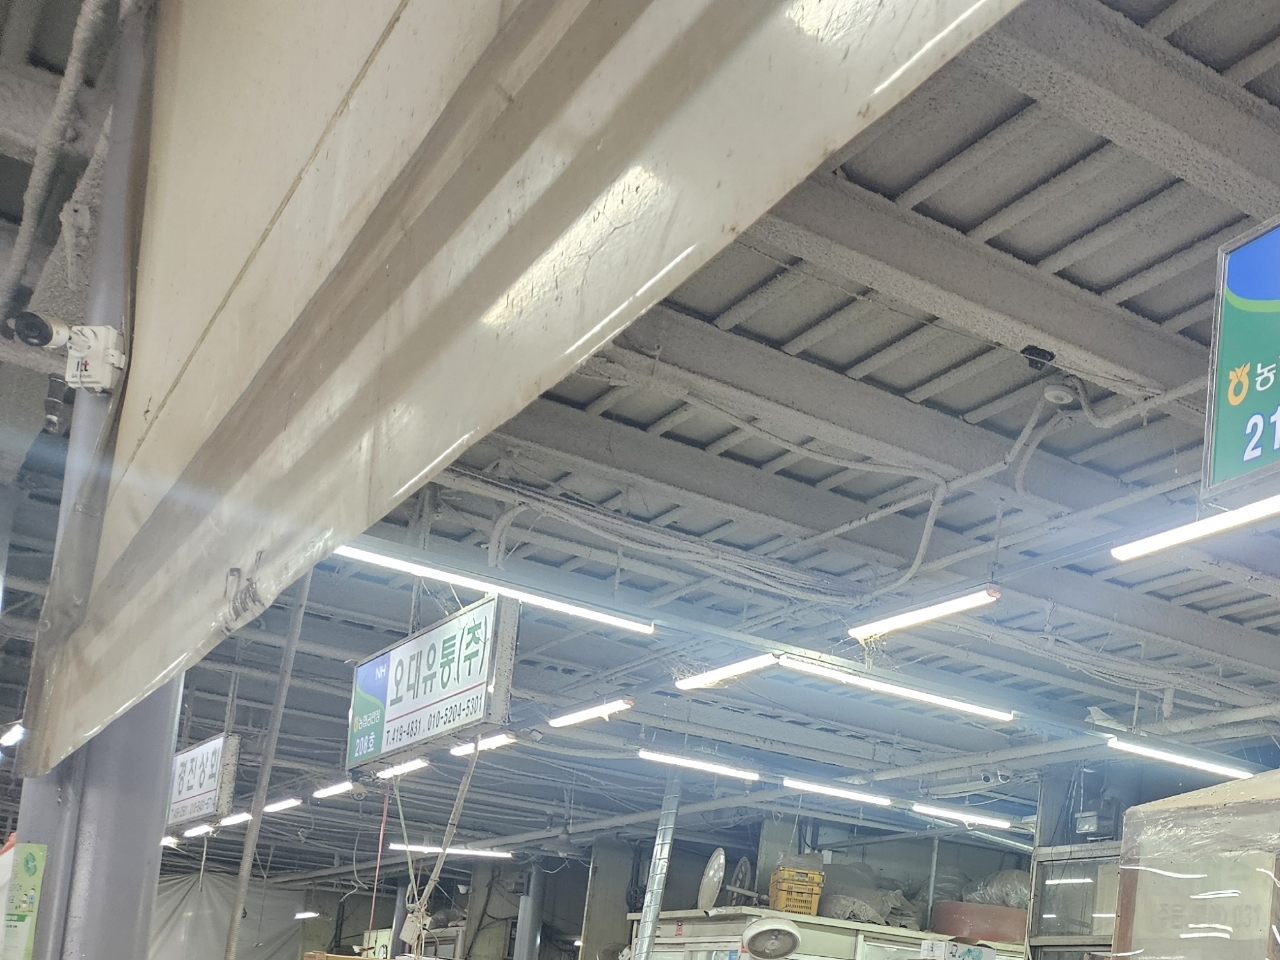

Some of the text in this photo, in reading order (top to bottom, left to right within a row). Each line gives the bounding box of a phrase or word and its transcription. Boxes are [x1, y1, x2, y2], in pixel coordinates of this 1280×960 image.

[375, 664, 387, 681] NH
[389, 615, 488, 708] 오대유통(주)
[427, 693, 483, 732] 010-5204-5301
[354, 731, 376, 758] 208호
